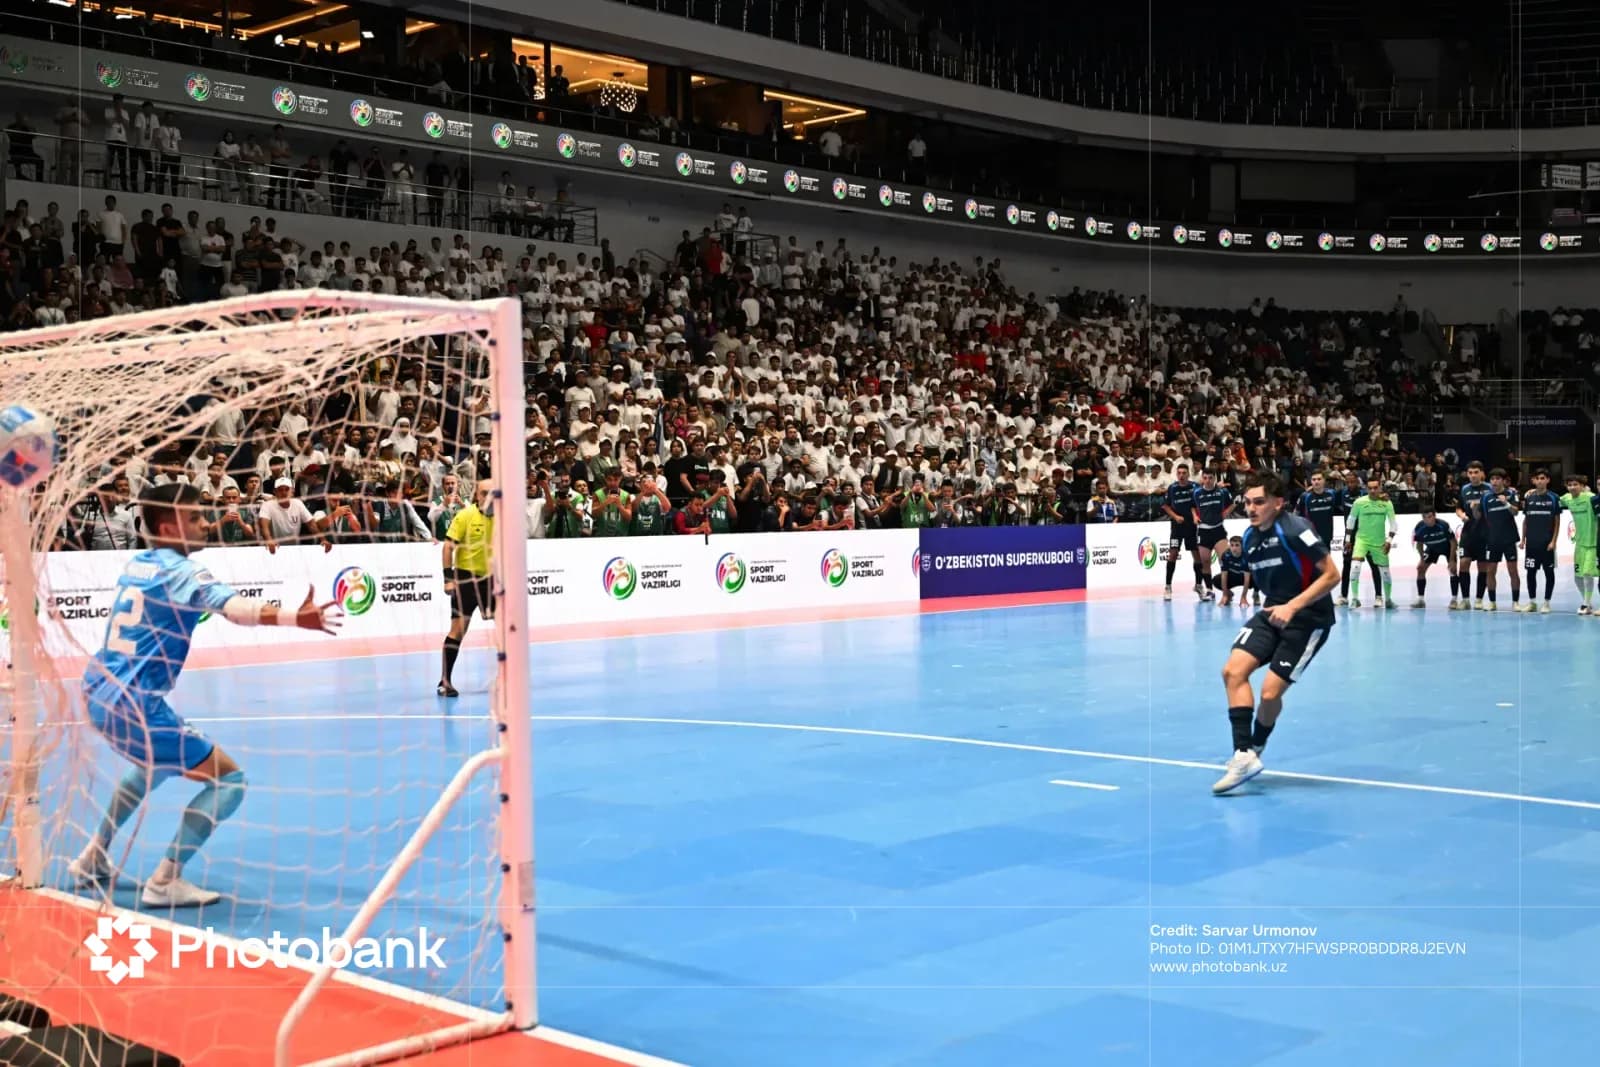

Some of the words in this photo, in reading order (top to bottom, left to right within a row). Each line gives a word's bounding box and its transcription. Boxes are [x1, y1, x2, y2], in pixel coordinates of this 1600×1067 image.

[1006, 551, 1074, 566] SUPERKUBOGI
[1092, 550, 1110, 558] SPORT
[851, 560, 874, 569] SPORT
[1526, 558, 1535, 568] 26
[750, 565, 774, 574] SPORT
[851, 569, 884, 578] VAZIRLIGI
[528, 575, 549, 585] ORT
[641, 570, 668, 580] SPORT
[750, 574, 786, 583] VAZIRLIGI
[381, 581, 416, 592] SPORT
[641, 580, 681, 589] VAZIRLIGI
[237, 588, 263, 598] ORT
[527, 585, 563, 595] ZIRLIGI
[47, 595, 92, 608] SPORT
[381, 592, 432, 603] VAZIRLIGI
[107, 586, 145, 656] 2
